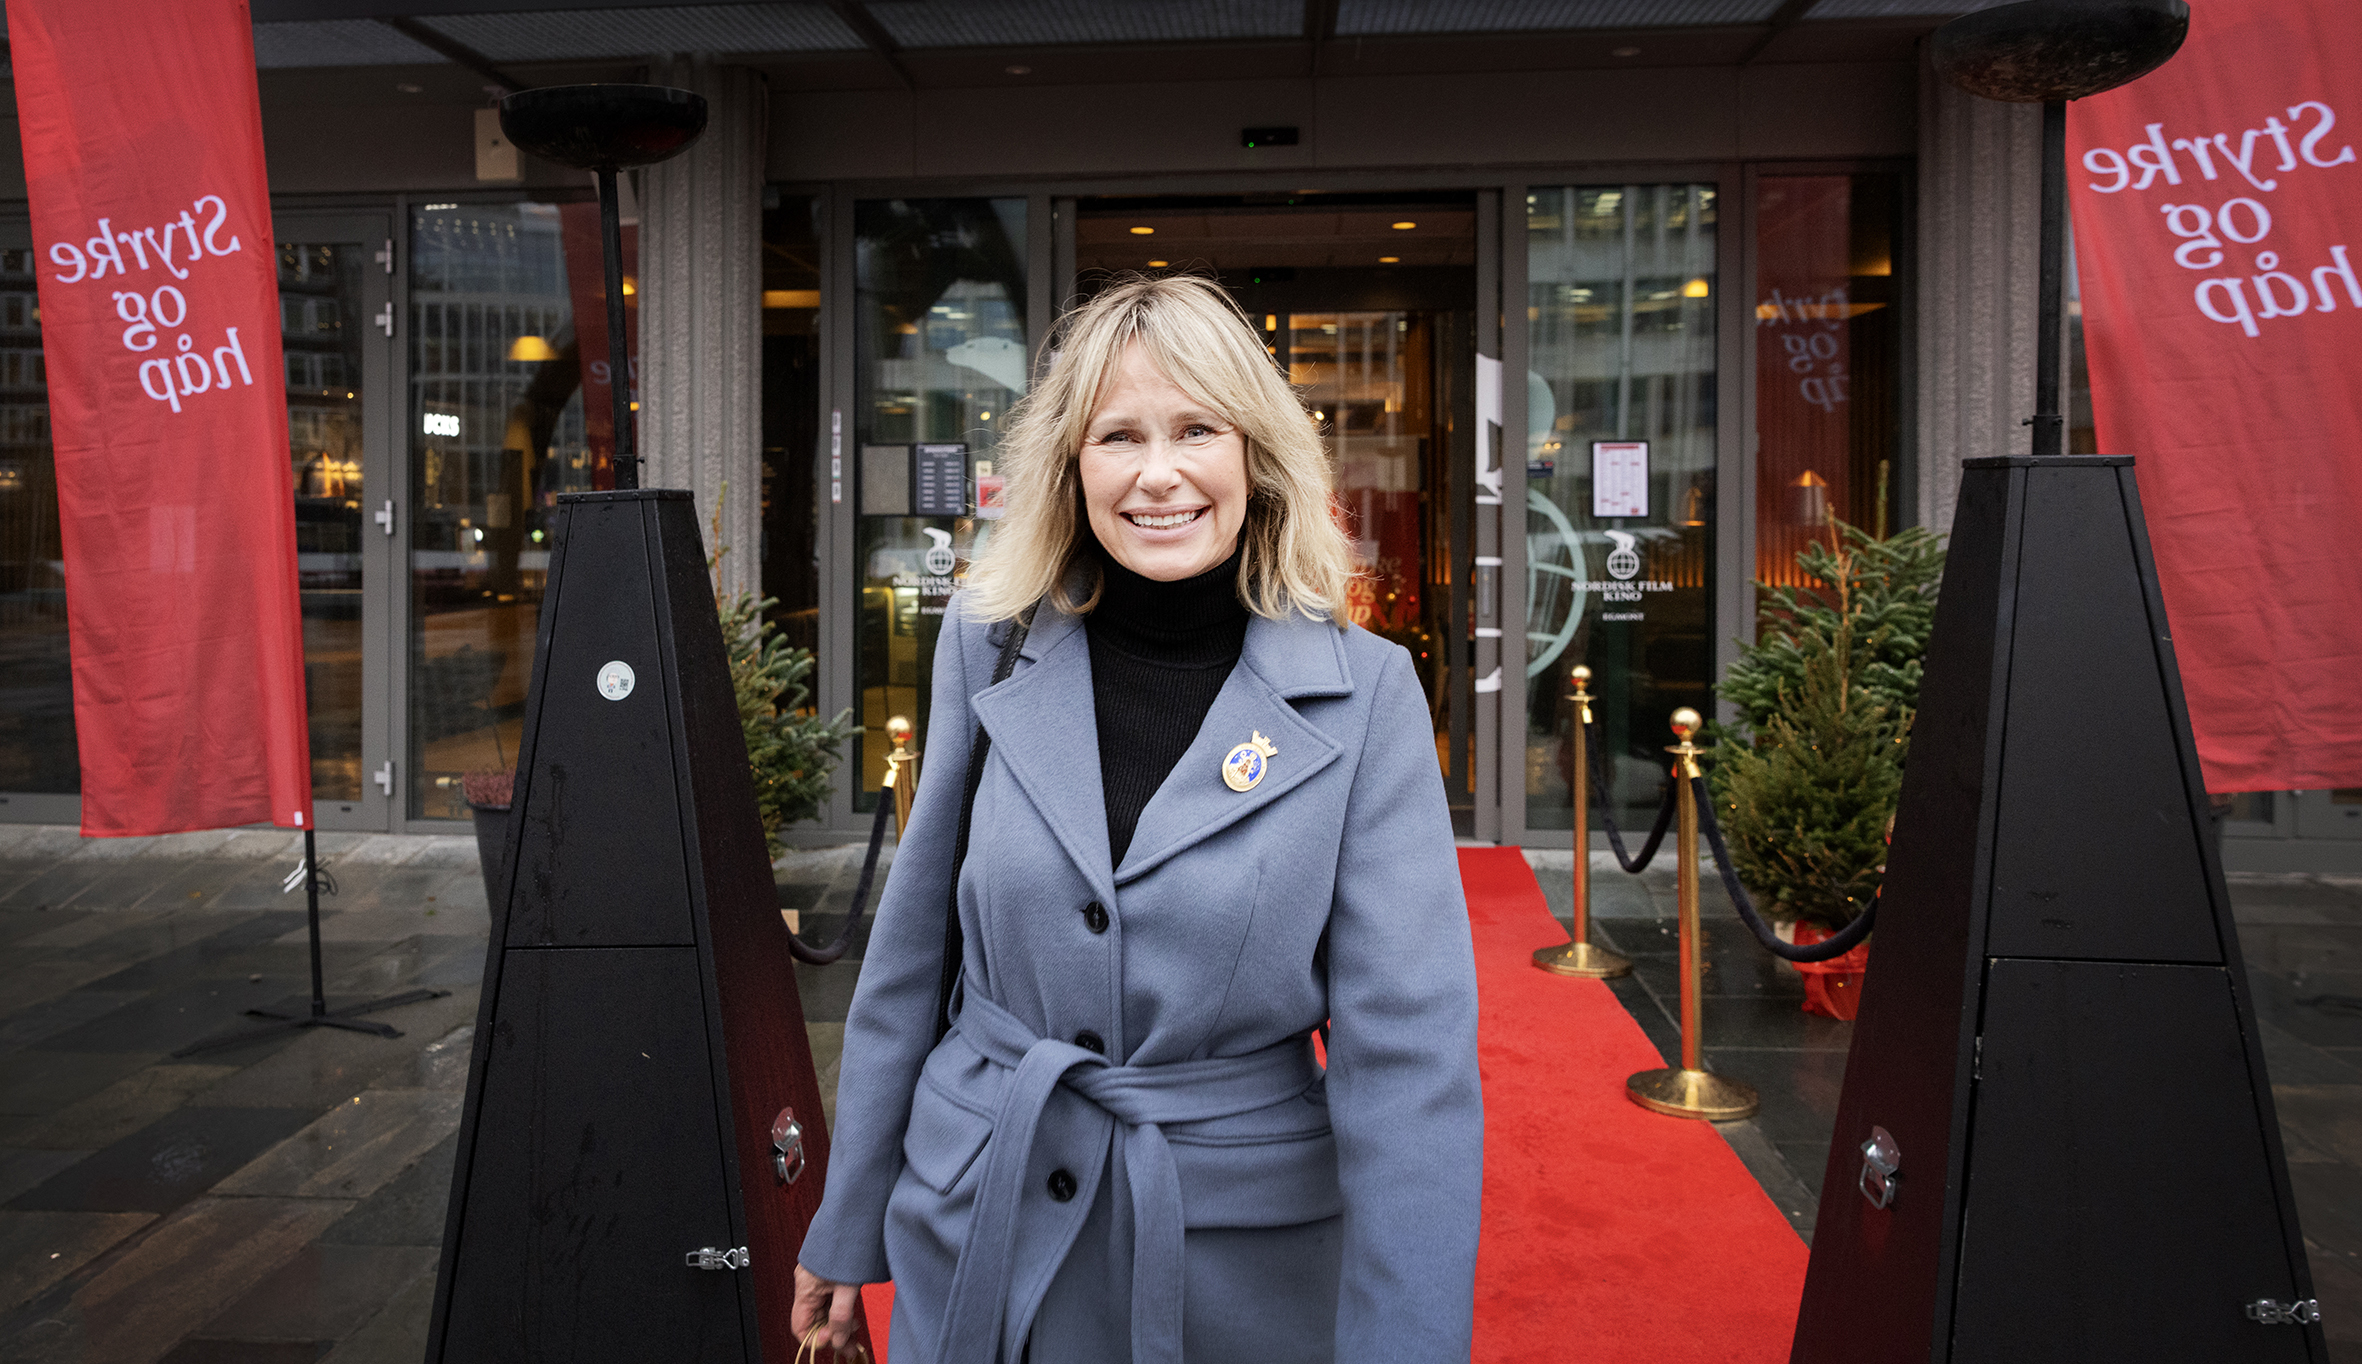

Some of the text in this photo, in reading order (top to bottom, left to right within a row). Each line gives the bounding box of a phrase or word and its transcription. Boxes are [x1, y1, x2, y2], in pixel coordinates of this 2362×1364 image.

[1571, 581, 1674, 592] NORDISK FILM
[1602, 591, 1643, 602] KINO
[1602, 612, 1644, 622] EGMONT
